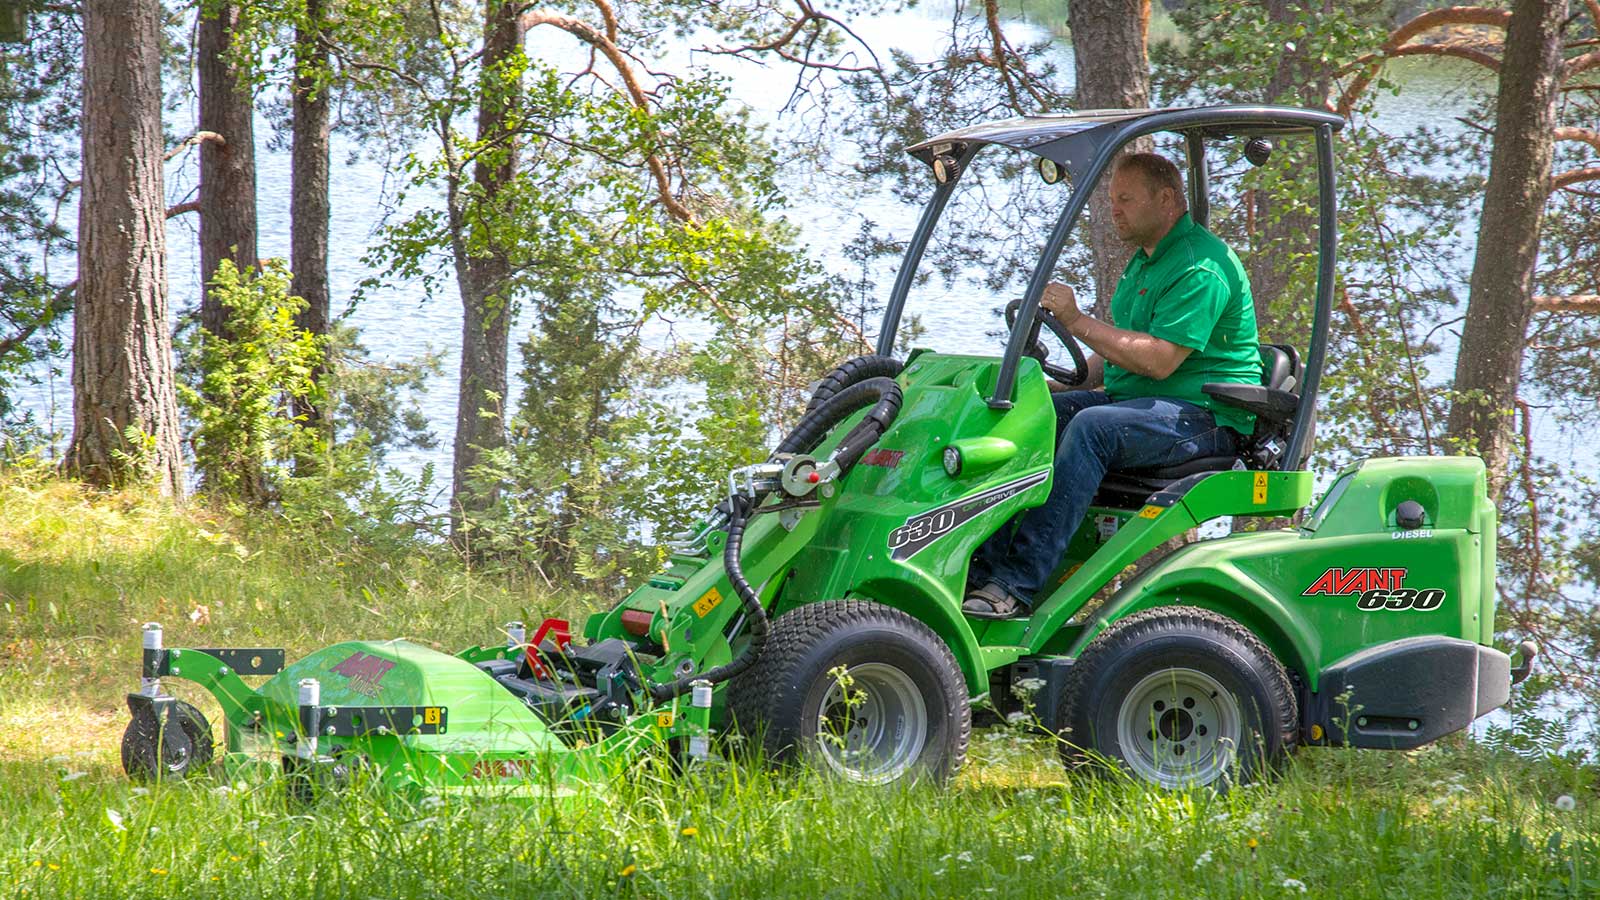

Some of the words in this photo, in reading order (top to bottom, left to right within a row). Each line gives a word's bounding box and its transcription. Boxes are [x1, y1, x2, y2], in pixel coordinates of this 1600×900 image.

[887, 508, 955, 549] 630
[1391, 529, 1433, 540] DIESEL
[1301, 567, 1408, 596] AVANT
[1356, 588, 1446, 612] 630
